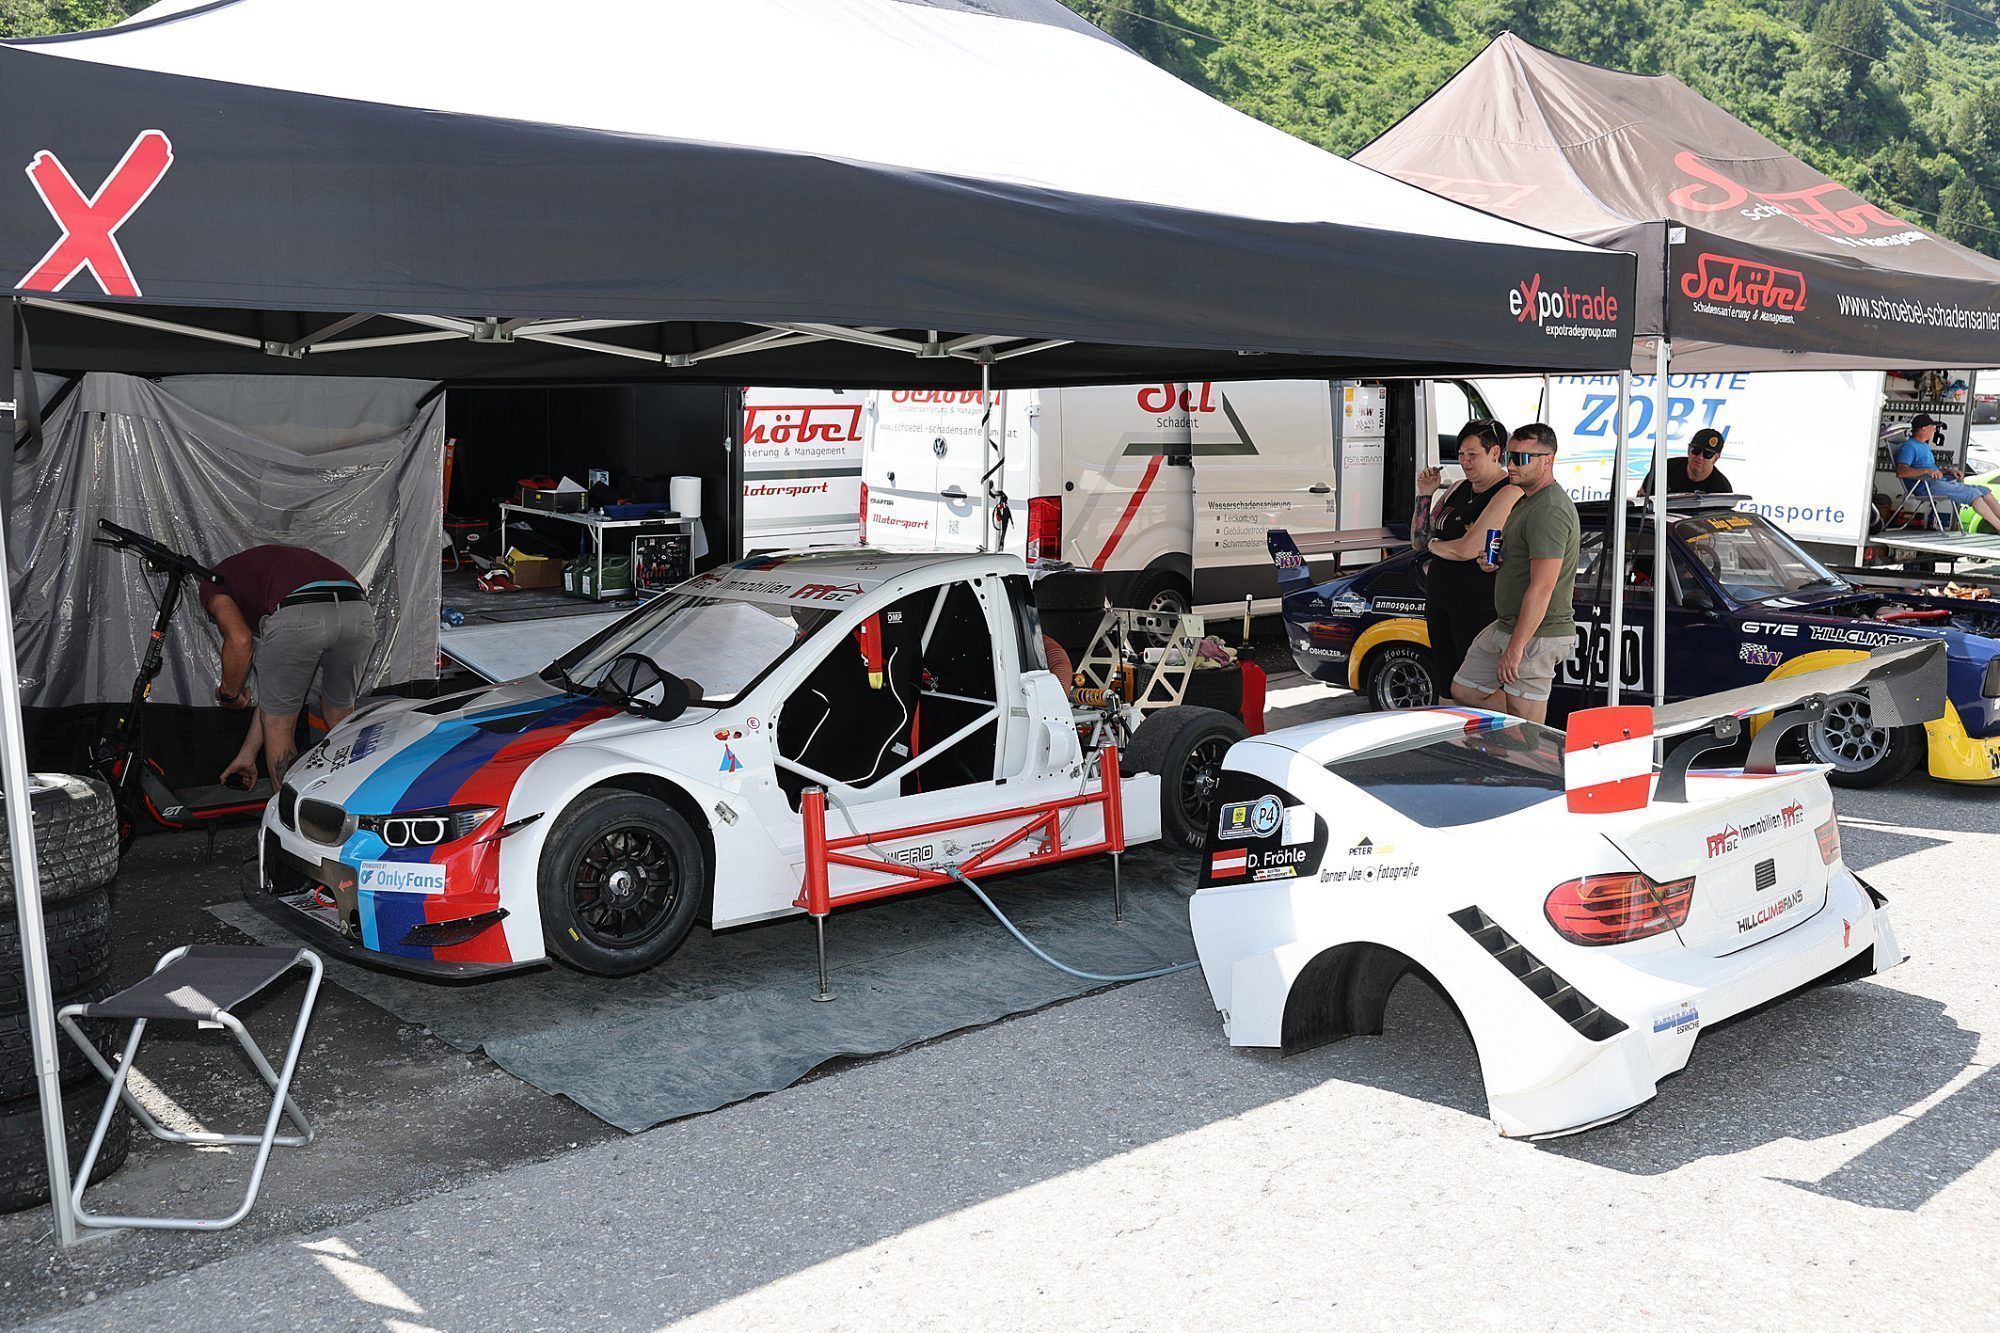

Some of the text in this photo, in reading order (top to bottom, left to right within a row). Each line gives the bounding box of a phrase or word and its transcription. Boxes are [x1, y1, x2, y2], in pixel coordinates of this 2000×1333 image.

[1681, 253, 1807, 311] Schöbel
[1693, 301, 1751, 322] Schadensanierung
[1752, 308, 1759, 320] &
[1545, 324, 1617, 340] expotradegroup.com
[800, 447, 847, 458] Management
[873, 513, 930, 530] Motorsport
[1740, 502, 1846, 524] ransporte
[1375, 600, 1426, 613] anno1940.at
[1741, 621, 1799, 637] GT/E
[1746, 649, 1783, 667] KW
[1258, 806, 1275, 825] P4
[1739, 815, 1783, 841] Immobilien
[1247, 847, 1307, 868] D. Fröhle
[1348, 846, 1373, 856] PETER
[377, 870, 443, 890] OnlyFans
[1736, 889, 1804, 934] HILLCLIMBFANS
